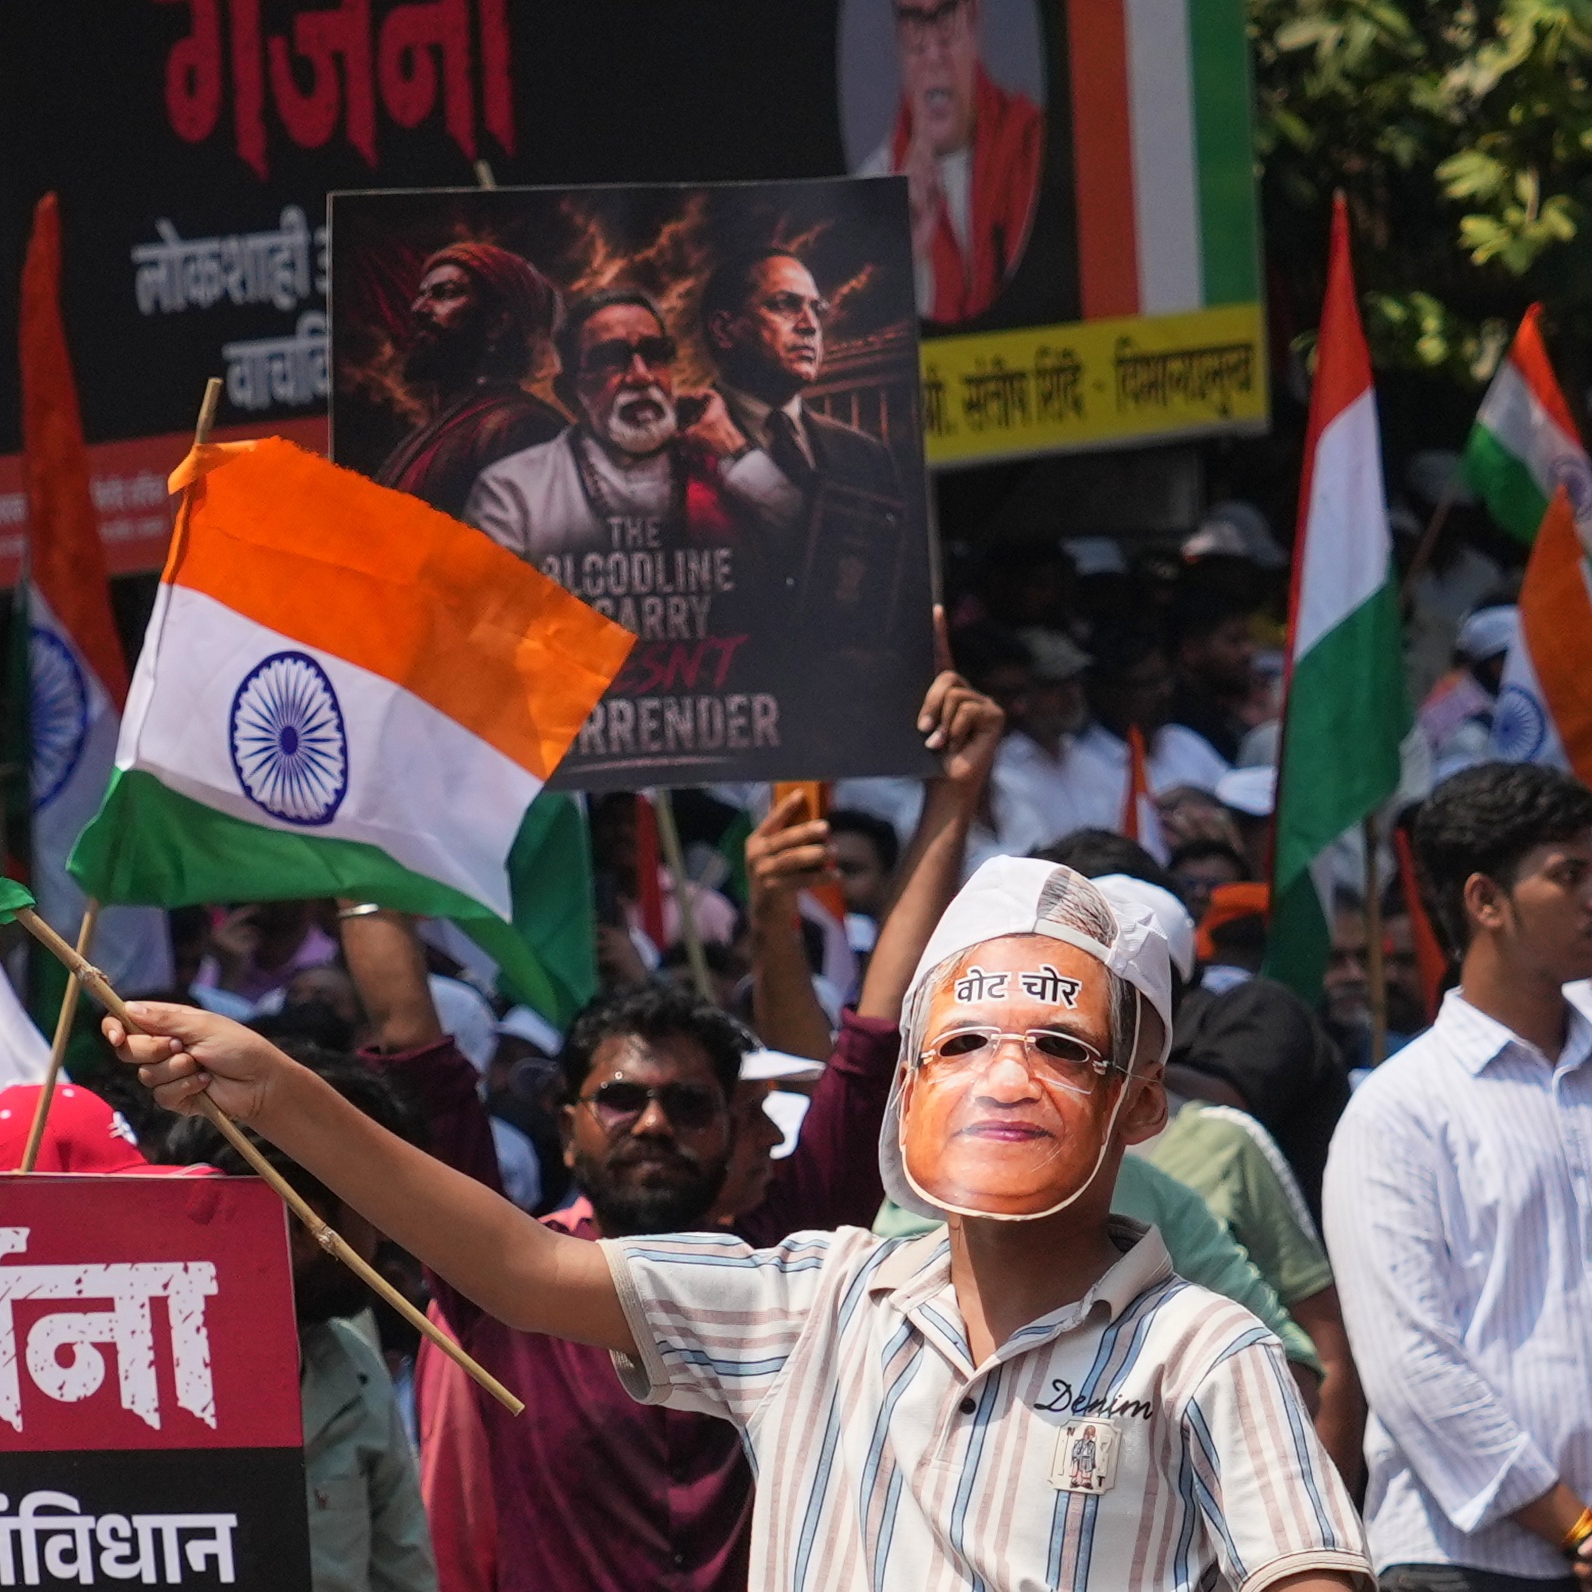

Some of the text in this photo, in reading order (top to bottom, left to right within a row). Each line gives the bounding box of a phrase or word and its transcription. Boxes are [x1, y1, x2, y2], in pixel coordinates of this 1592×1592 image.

[130, 206, 312, 314] लोकशाही
[608, 517, 661, 549] THE
[957, 966, 1081, 1007] वोट चोर
[1033, 1378, 1154, 1420] Denim
